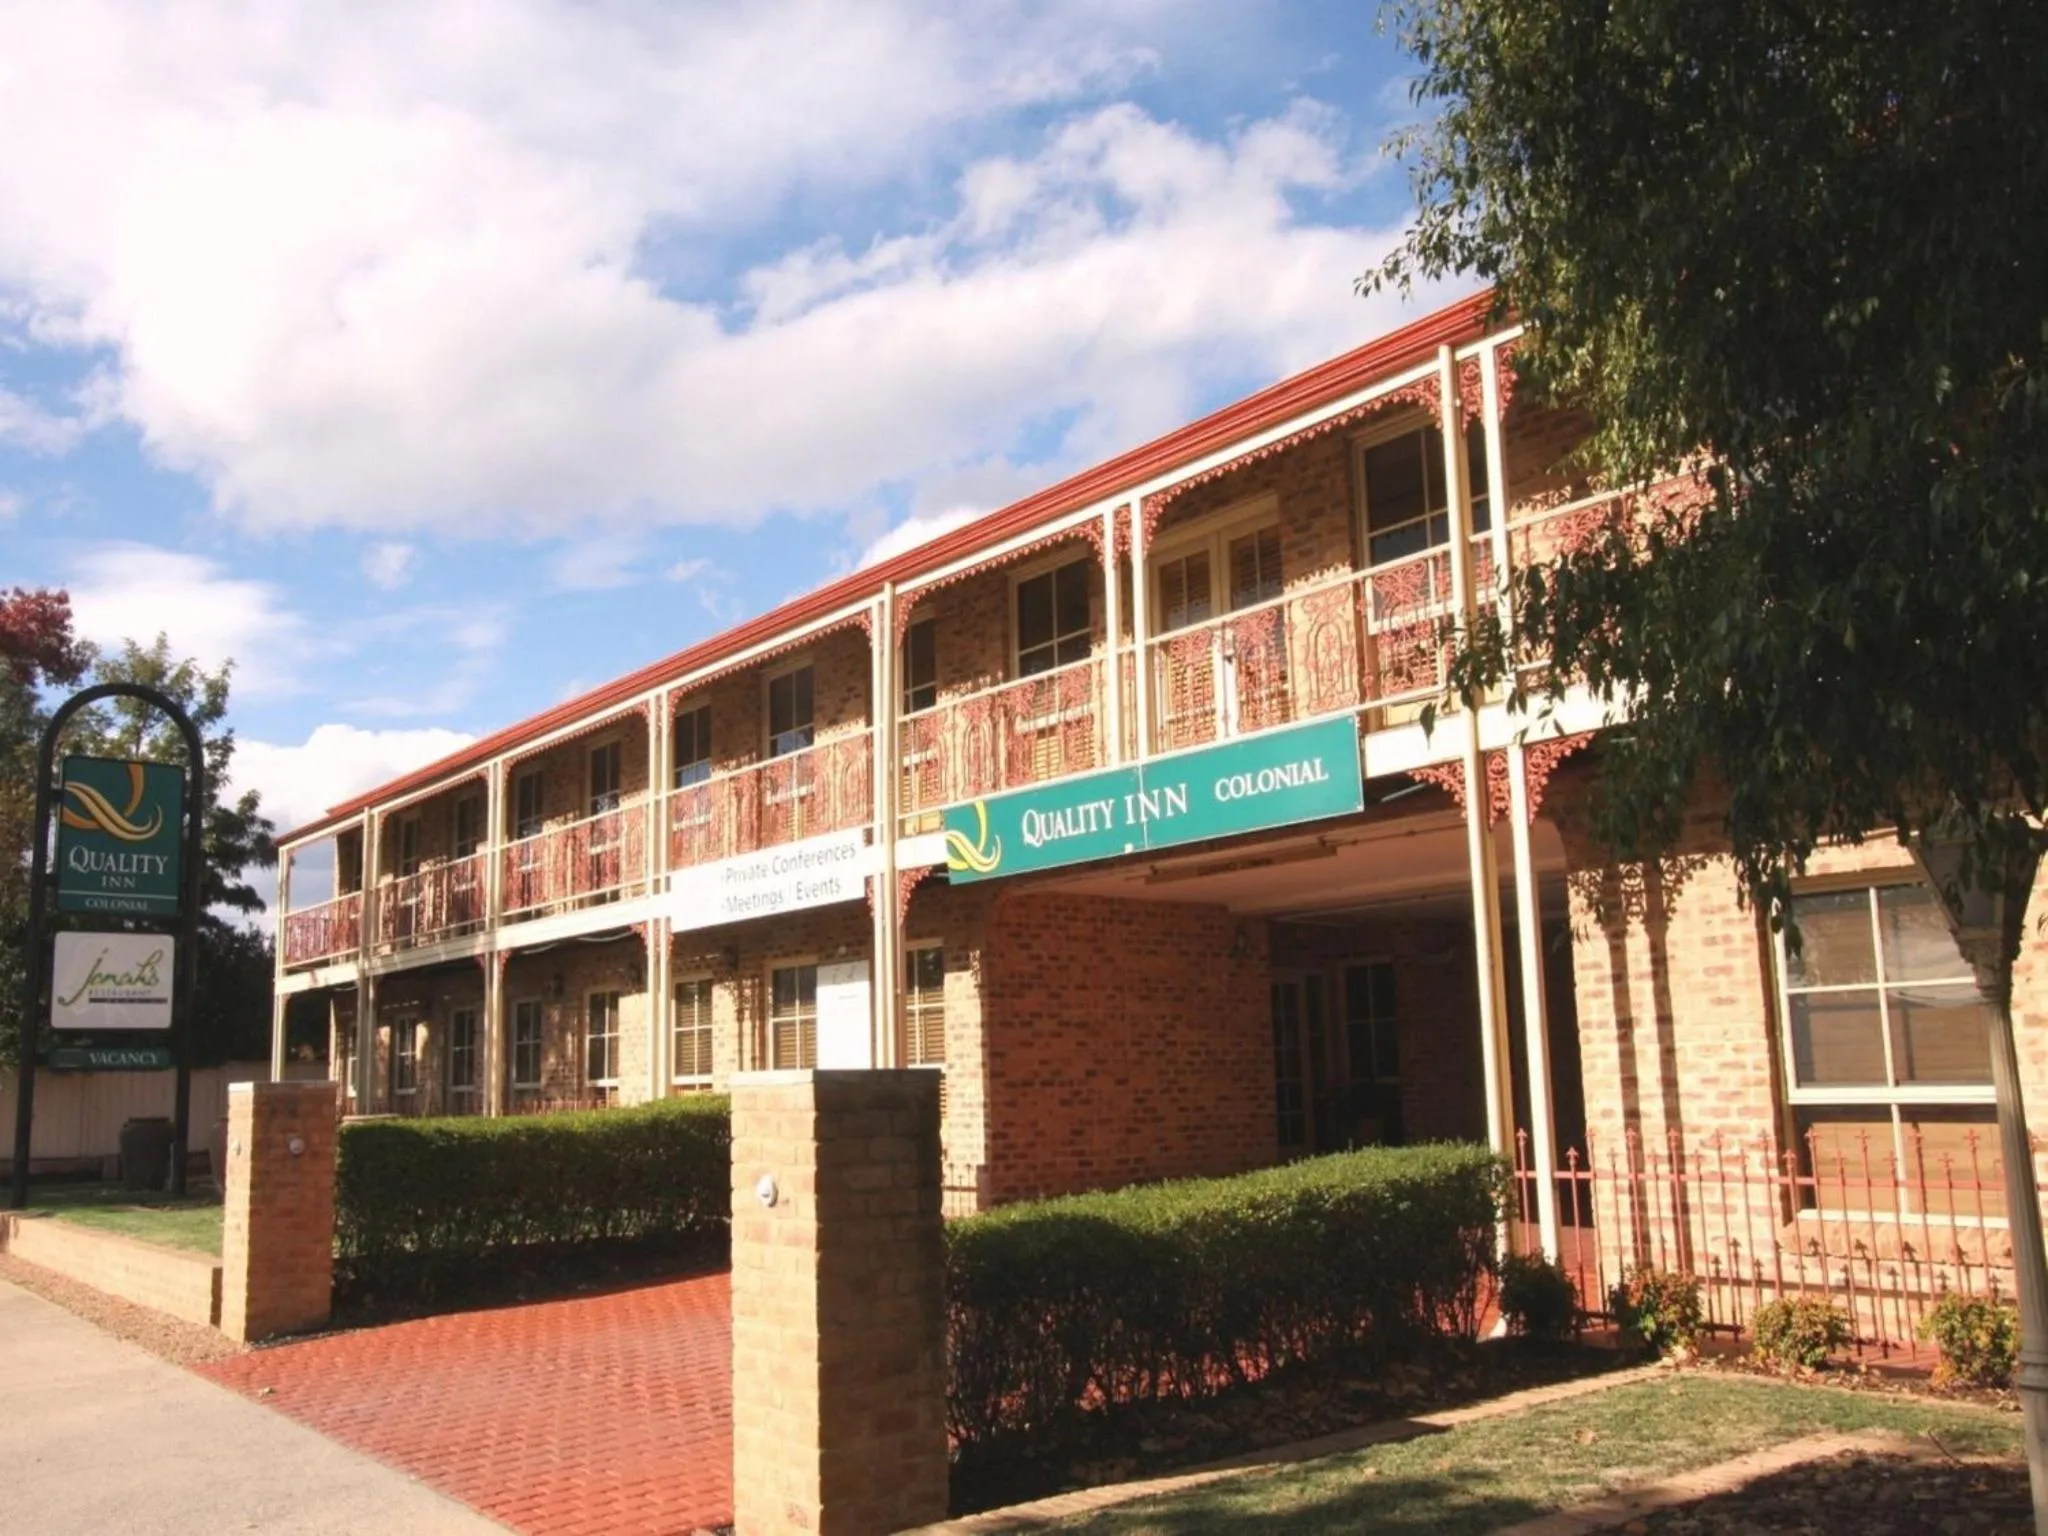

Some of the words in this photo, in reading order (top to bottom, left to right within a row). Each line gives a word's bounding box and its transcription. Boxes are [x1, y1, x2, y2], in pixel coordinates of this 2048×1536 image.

[1022, 798, 1115, 847] QUALITY
[1124, 783, 1189, 825] INN
[1214, 757, 1329, 802] COLONIAL
[68, 844, 169, 875] QUALITY
[725, 862, 769, 885] Private
[771, 842, 857, 876] Conferences
[101, 875, 136, 888] INN
[725, 889, 785, 914] Meetings
[795, 876, 842, 901] Events
[85, 897, 148, 910] COLONIAL
[89, 1051, 158, 1065] VACANCY
